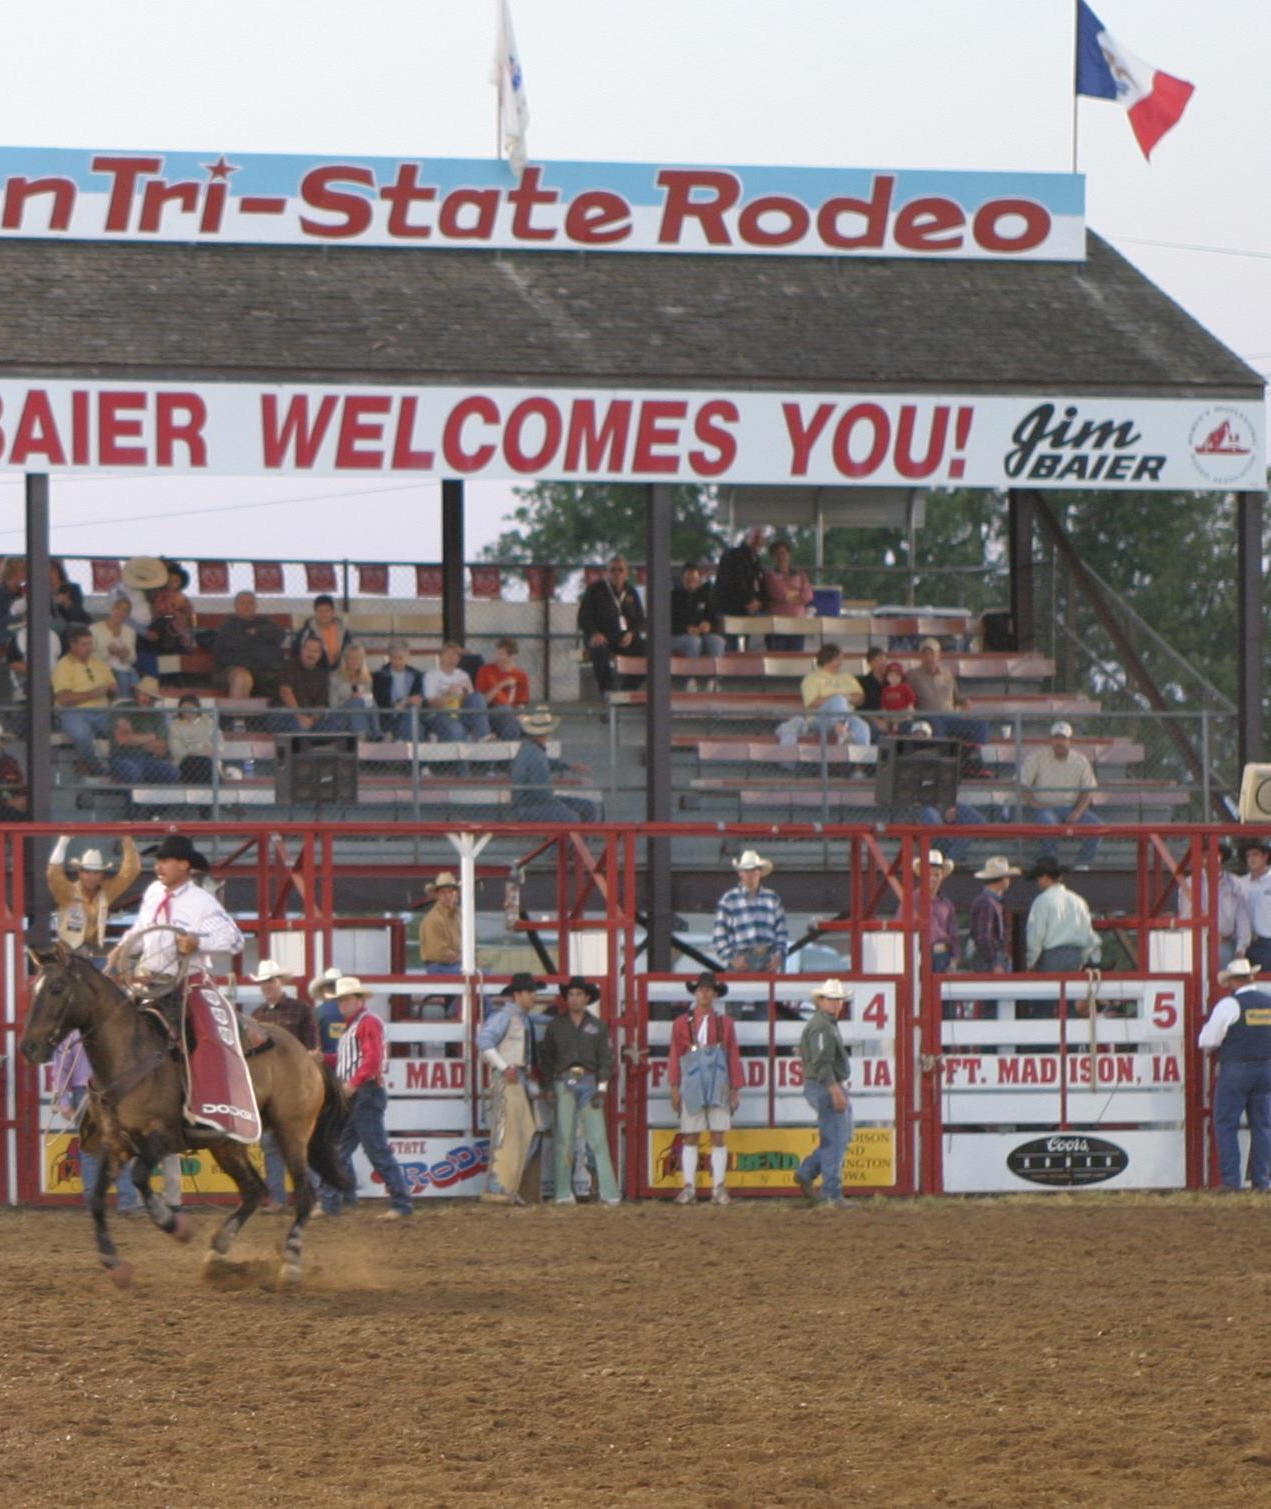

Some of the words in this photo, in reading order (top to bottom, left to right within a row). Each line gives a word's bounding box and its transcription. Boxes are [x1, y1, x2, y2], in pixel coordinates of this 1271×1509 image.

[90, 156, 633, 245] Tri-State
[655, 169, 1052, 252] Rodeo
[261, 394, 741, 477] WELCOMES
[782, 402, 974, 480] YOU!
[1004, 401, 1142, 479] Jim
[1027, 454, 1168, 481] BAIER
[861, 992, 889, 1031] 4
[1152, 991, 1178, 1029] 5
[863, 1060, 892, 1087] IA
[945, 1057, 987, 1085] FT.
[1152, 1056, 1181, 1083] IA
